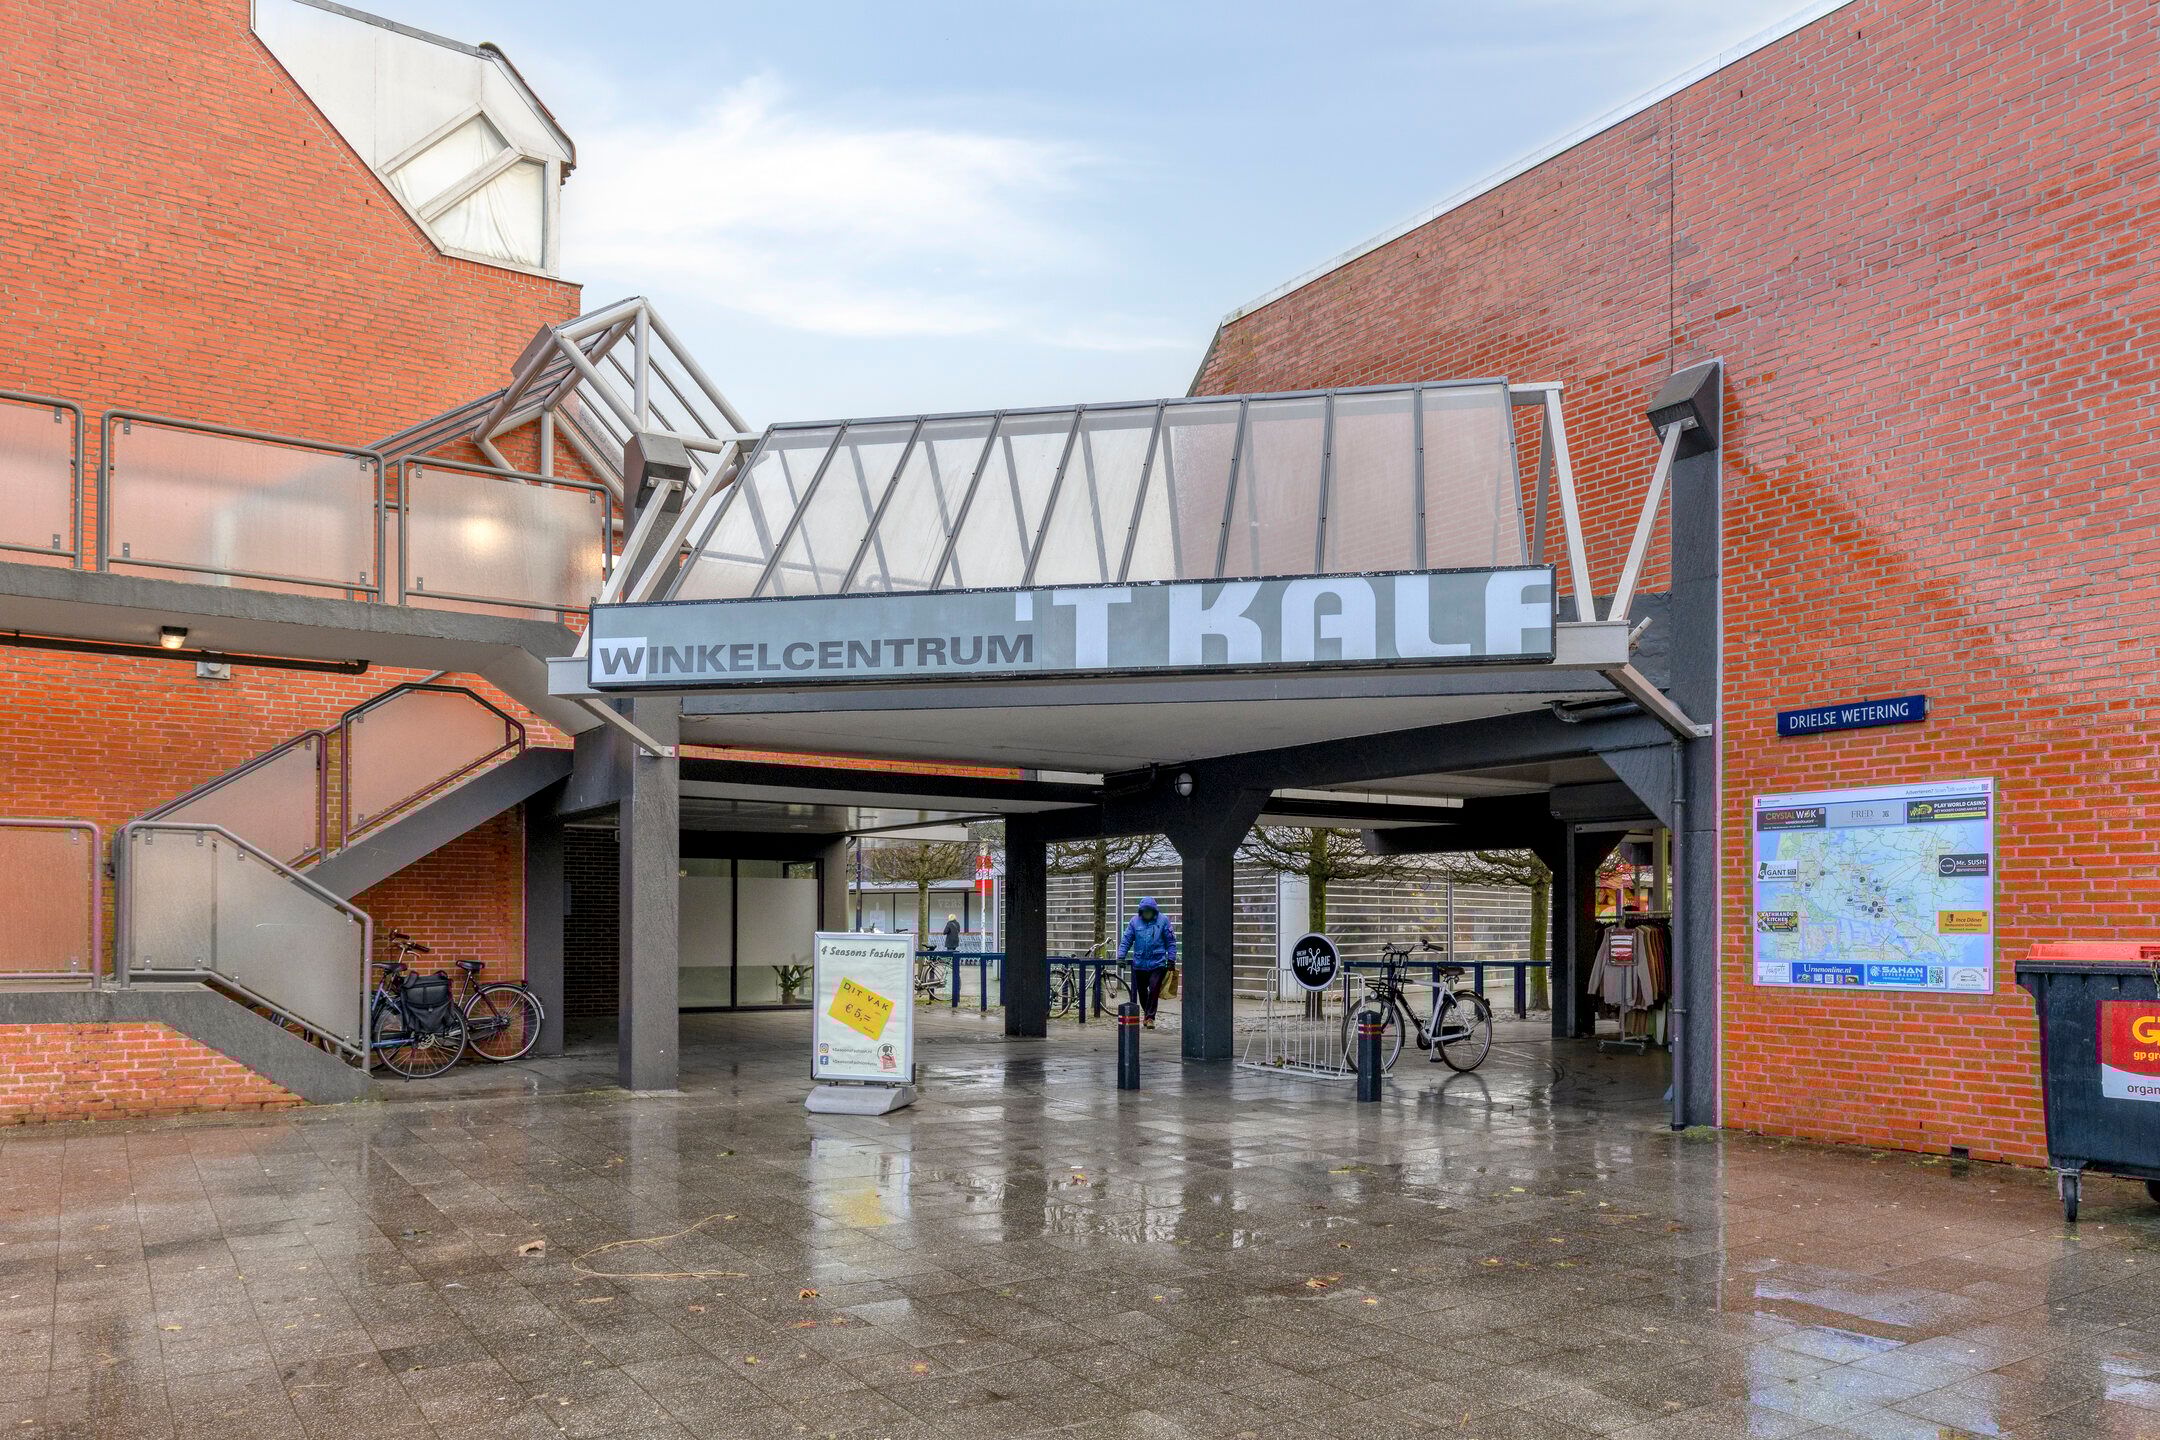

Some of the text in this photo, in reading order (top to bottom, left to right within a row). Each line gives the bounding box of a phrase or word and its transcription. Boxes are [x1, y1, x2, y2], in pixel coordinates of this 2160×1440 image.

[598, 633, 1033, 675] WINKELCENTRUM
[1789, 702, 1909, 730] DRIELSE WETERING
[1765, 811, 1796, 821] CRYSTAL
[821, 945, 906, 960] 4 Seasons Fashion
[1803, 963, 1852, 974] Urnenonline.nl
[1881, 966, 1924, 974] SAHAN
[843, 982, 889, 1011] DIT VAK
[2133, 1051, 2146, 1061] gp
